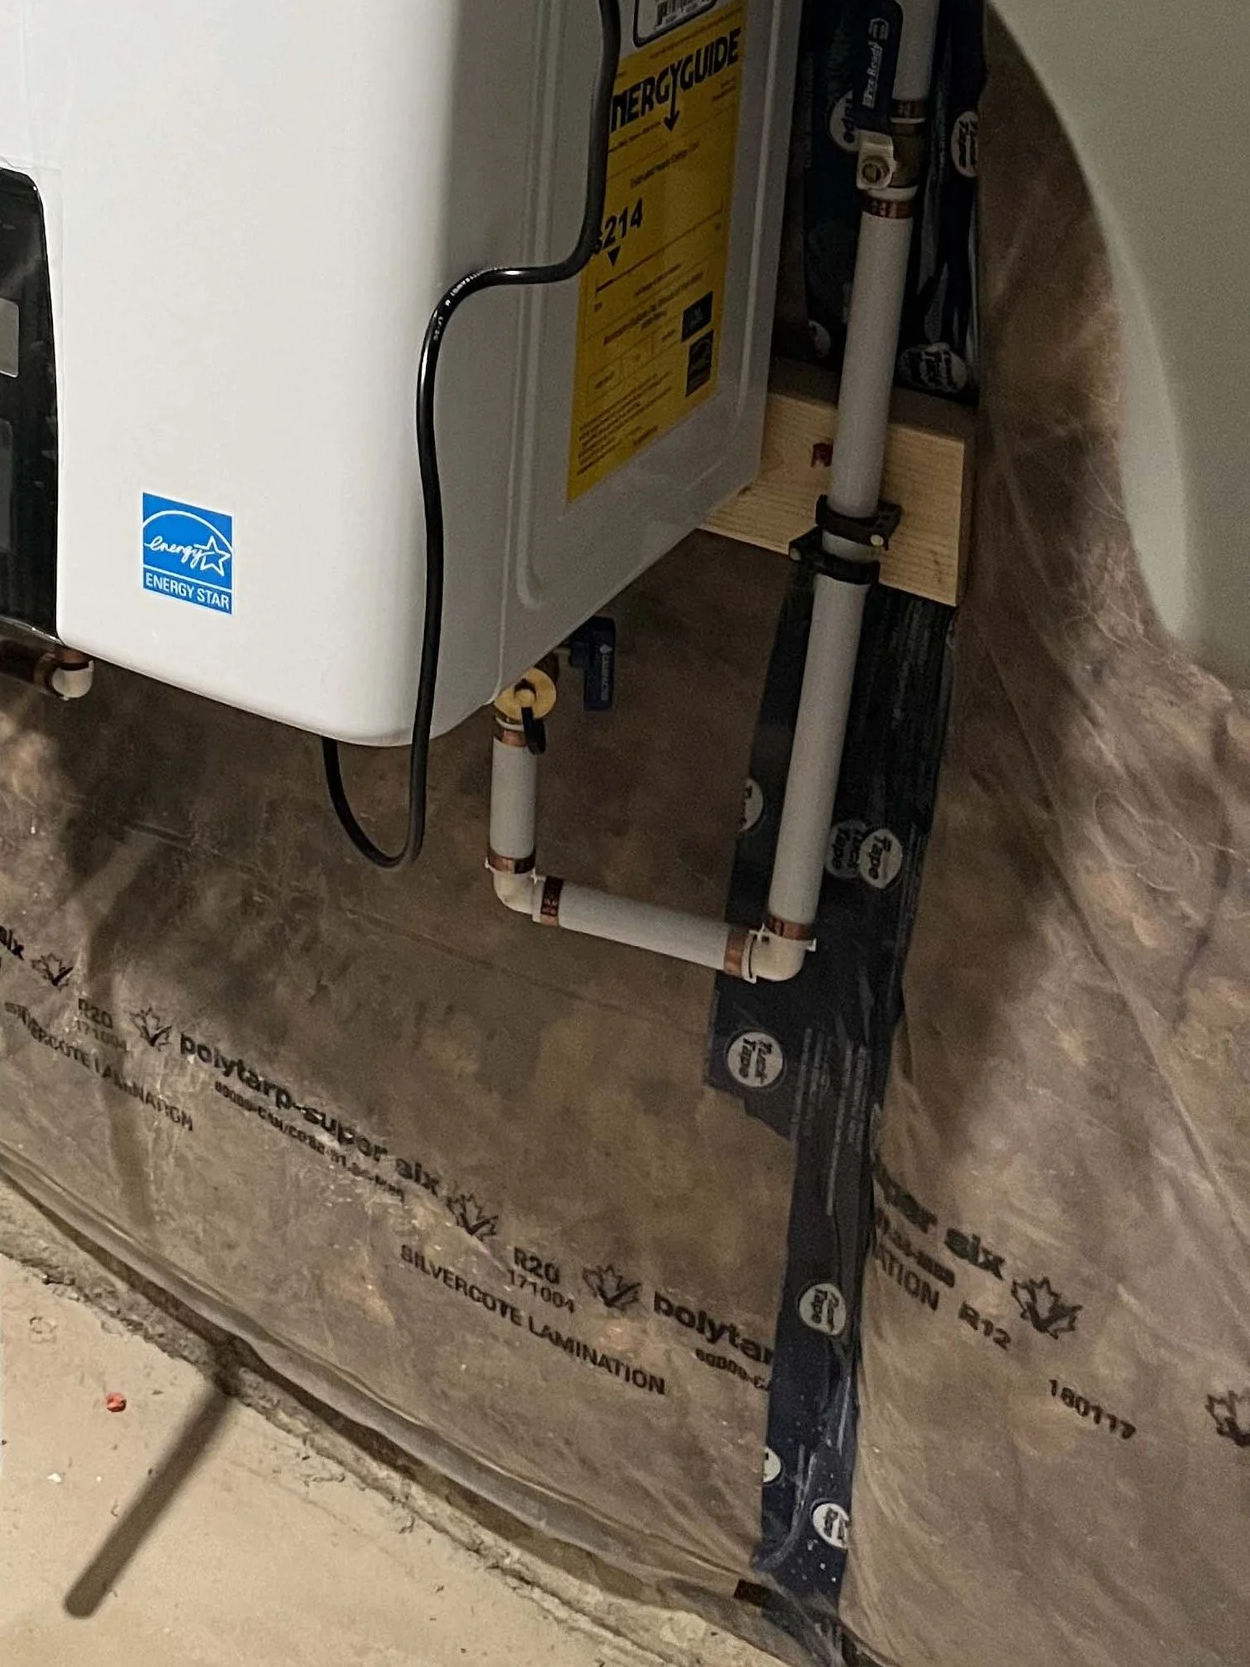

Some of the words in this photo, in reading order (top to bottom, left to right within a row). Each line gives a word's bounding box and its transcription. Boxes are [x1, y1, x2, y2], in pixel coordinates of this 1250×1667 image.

[611, 27, 741, 133] NERGYGUIDE
[144, 536, 208, 569] energy
[145, 573, 195, 599] ENERGY
[197, 588, 230, 610] STAR
[514, 1246, 561, 1285] R20
[401, 1245, 523, 1327] SILVERCOTE
[528, 1315, 666, 1396] LAMINATION
